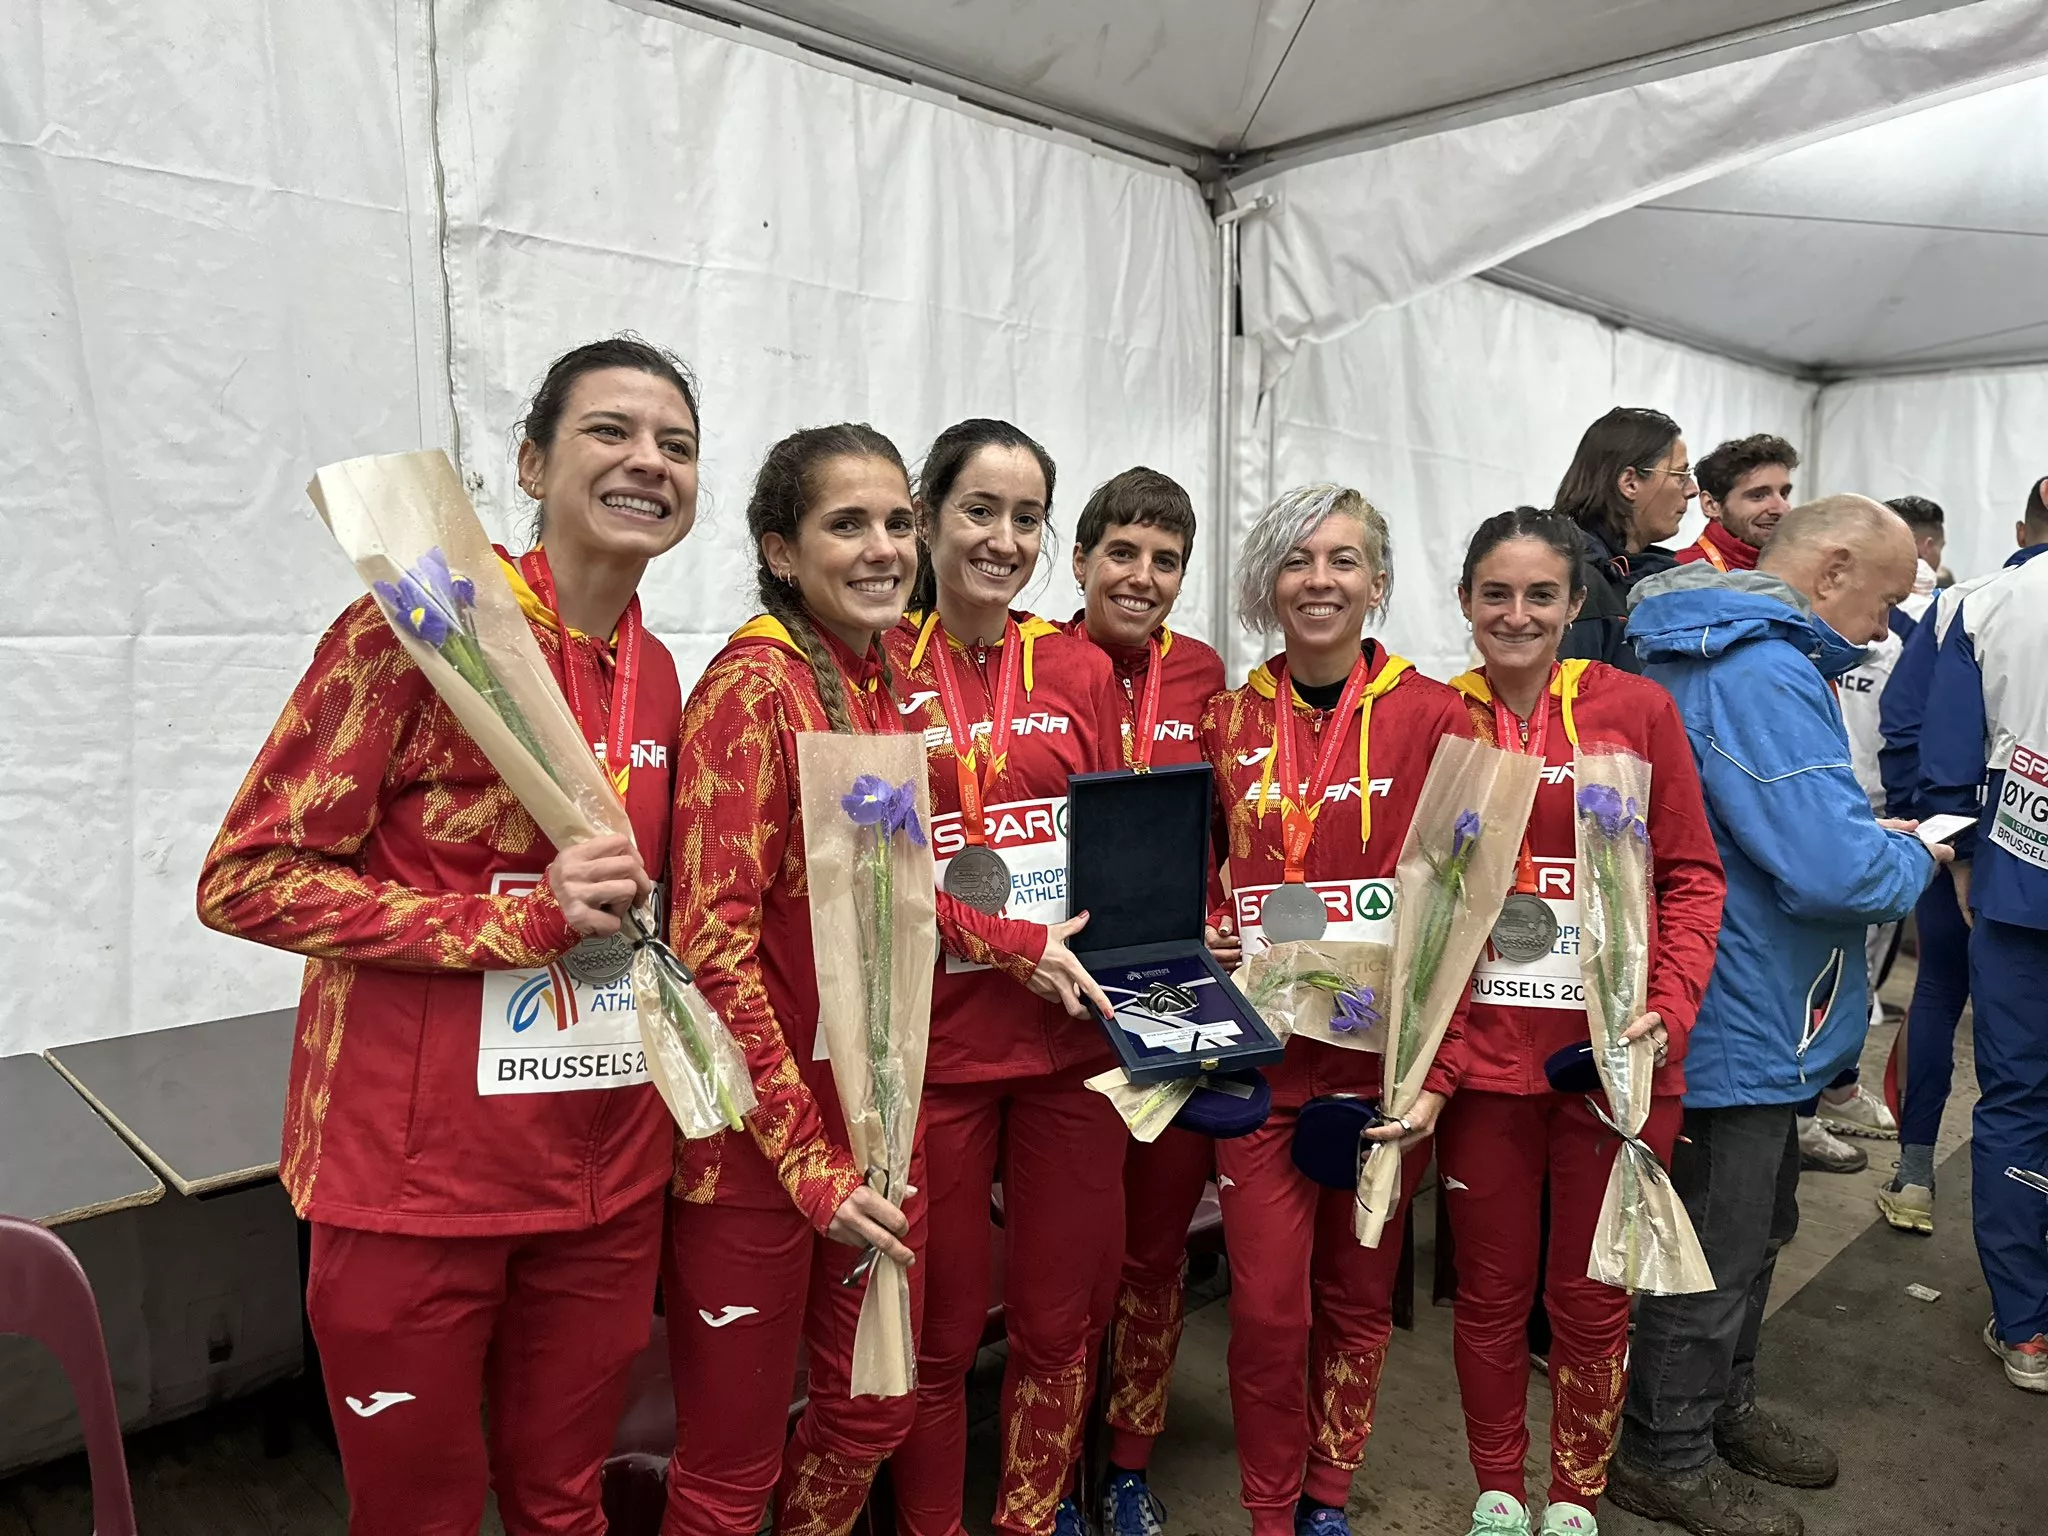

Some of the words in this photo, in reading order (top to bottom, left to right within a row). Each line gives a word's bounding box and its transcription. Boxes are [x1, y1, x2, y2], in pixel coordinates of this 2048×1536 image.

[569, 655, 580, 710] CHAMPIONSHIPS
[942, 669, 950, 690] COUNTRY
[618, 706, 626, 741] EUROPEAN
[1316, 758, 1328, 783] EUROPEAN
[1325, 743, 1333, 758] CROSS
[1331, 721, 1341, 743] COUNTRY
[2012, 749, 2048, 783] SP
[1997, 826, 2048, 863] BRUSSEL
[2016, 823, 2037, 840] RUN
[1015, 884, 1066, 905] ATHLE
[1241, 890, 1349, 921] SR
[1471, 979, 1555, 1001] RUSSELS
[498, 1052, 632, 1081] BRUSSELS
